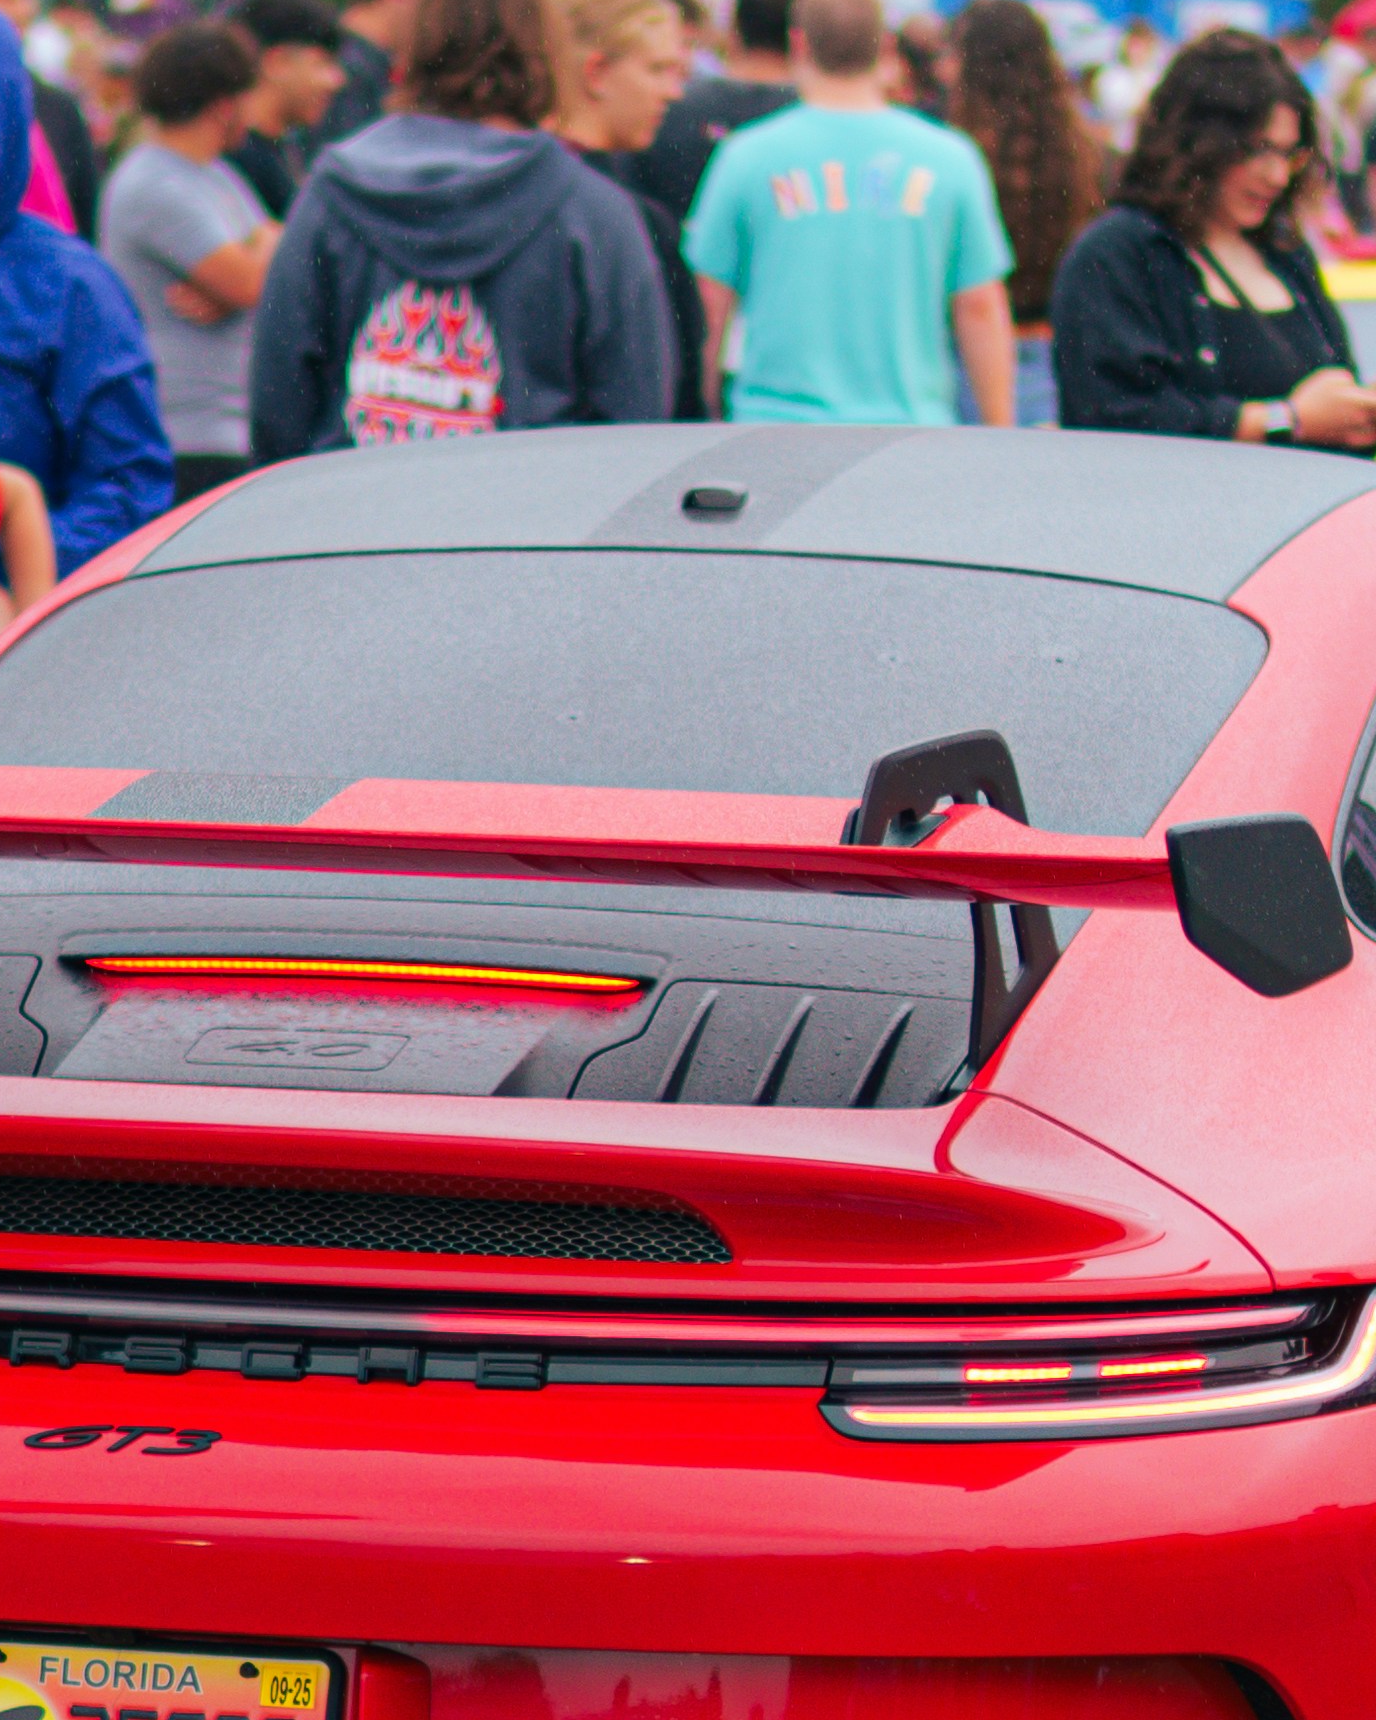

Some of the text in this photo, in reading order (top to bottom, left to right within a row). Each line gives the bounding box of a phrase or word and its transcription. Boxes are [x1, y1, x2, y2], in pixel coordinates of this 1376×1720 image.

[23, 1424, 223, 1456] GT3
[39, 1655, 203, 1694] FLORIDA
[270, 1675, 312, 1707] 09-25
